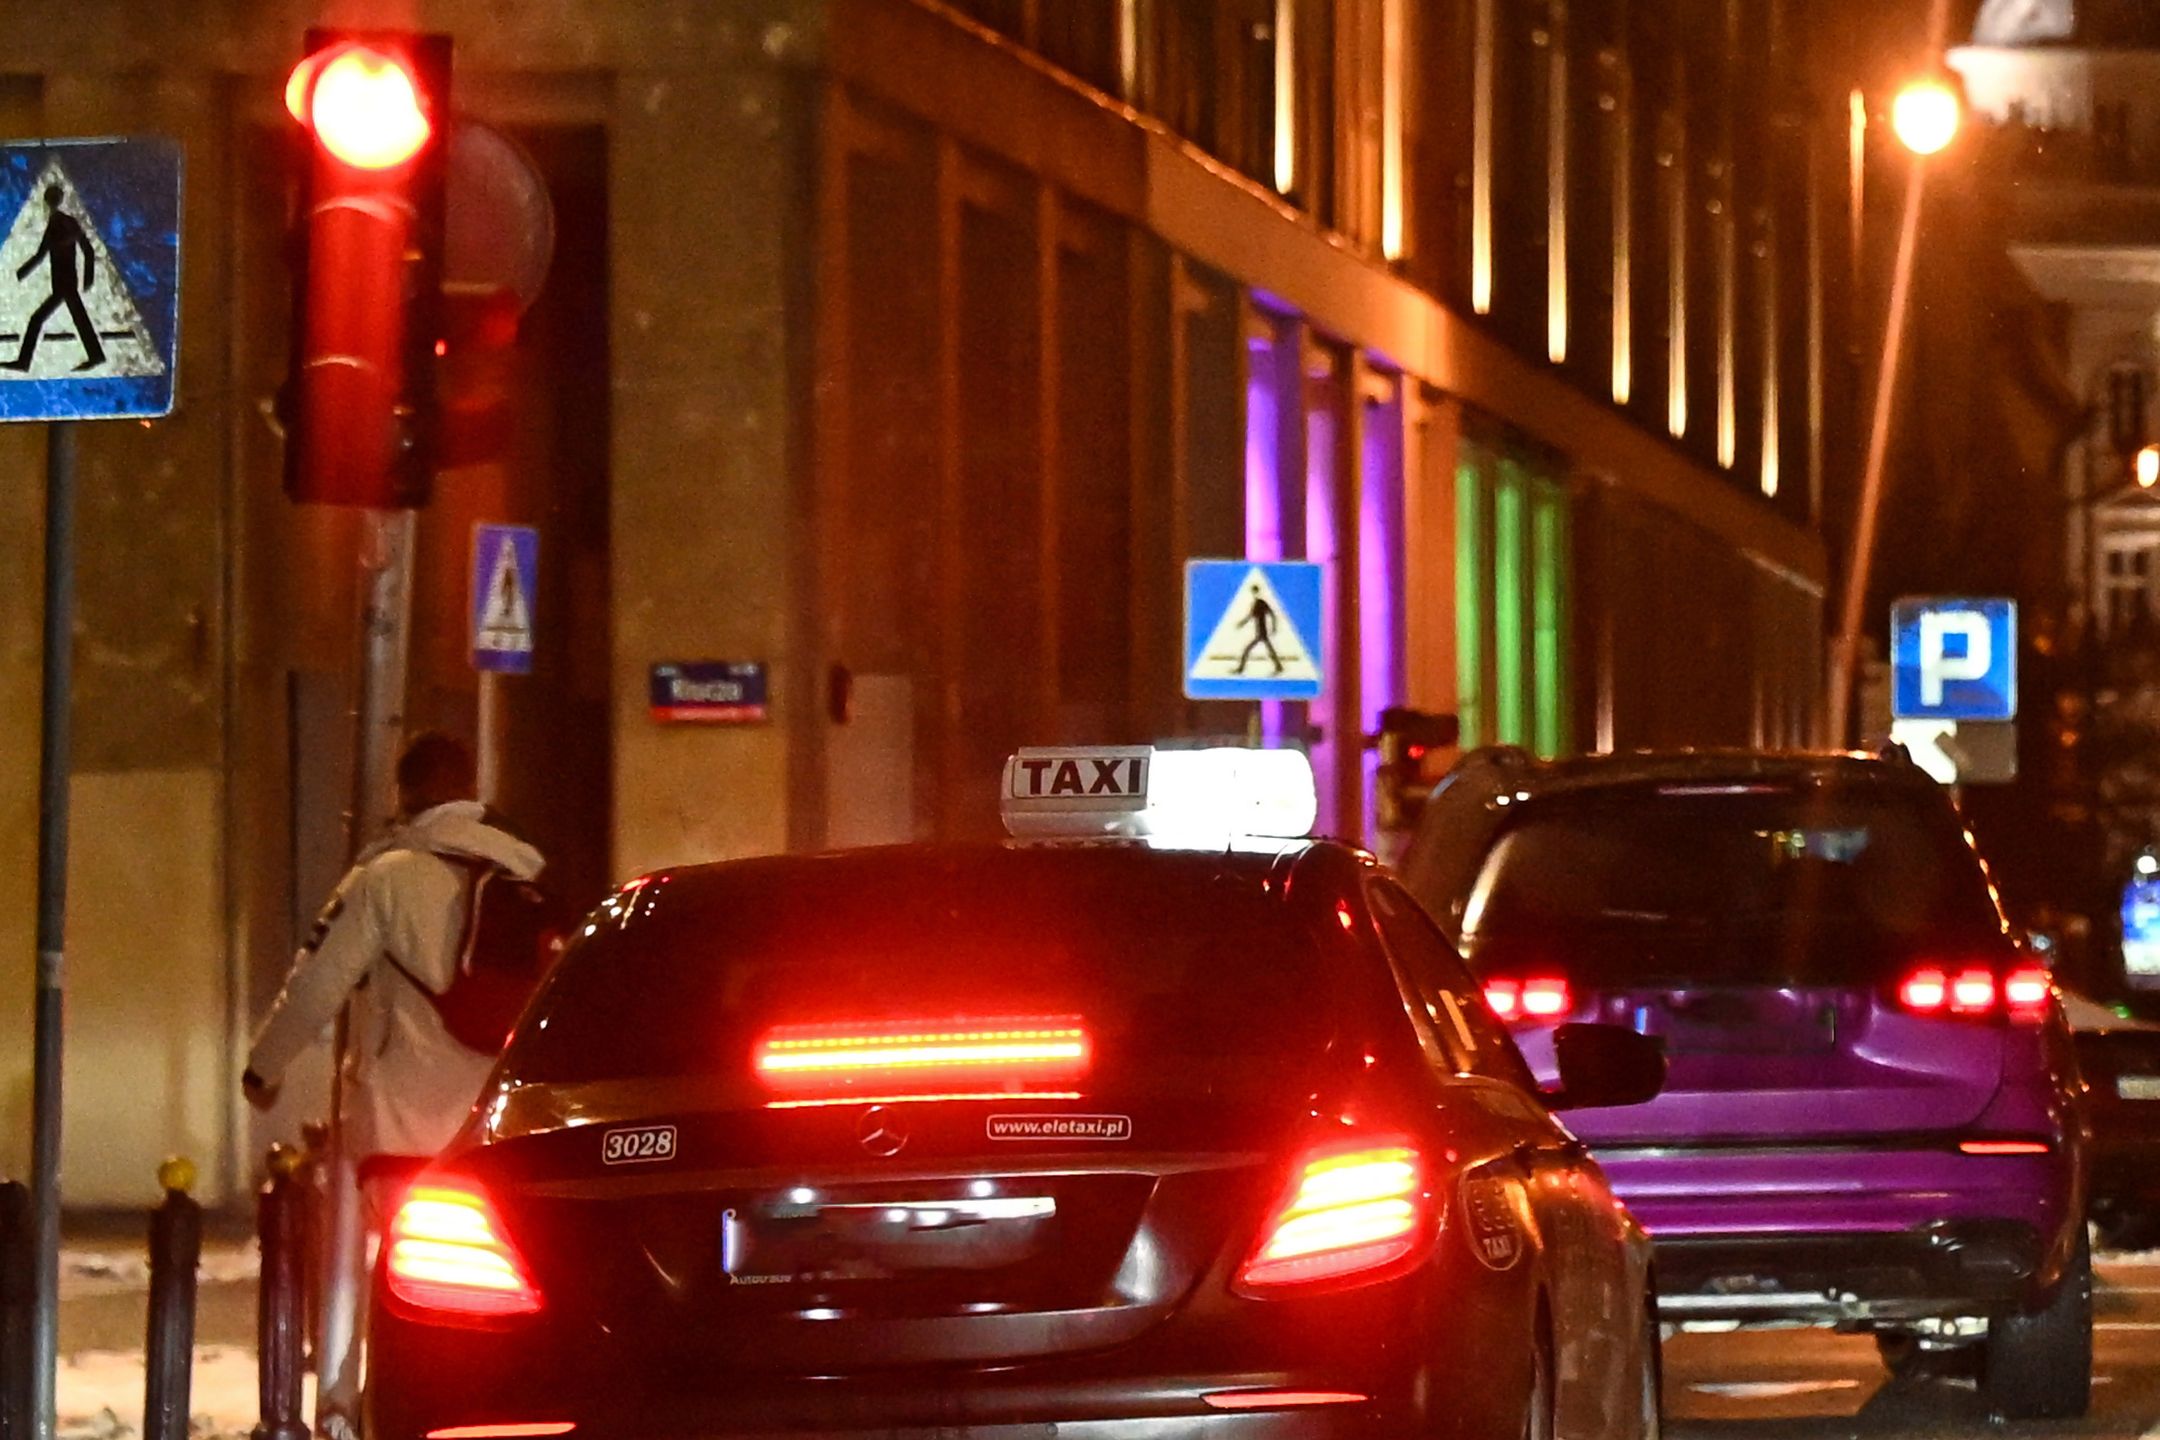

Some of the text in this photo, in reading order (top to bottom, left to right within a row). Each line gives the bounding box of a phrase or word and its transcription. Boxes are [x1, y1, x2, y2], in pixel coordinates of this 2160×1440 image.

[1920, 610, 1991, 707] P
[1022, 759, 1142, 795] TAXI
[607, 1130, 672, 1158] 3028
[994, 1120, 1124, 1136] www.eletaxi.pl
